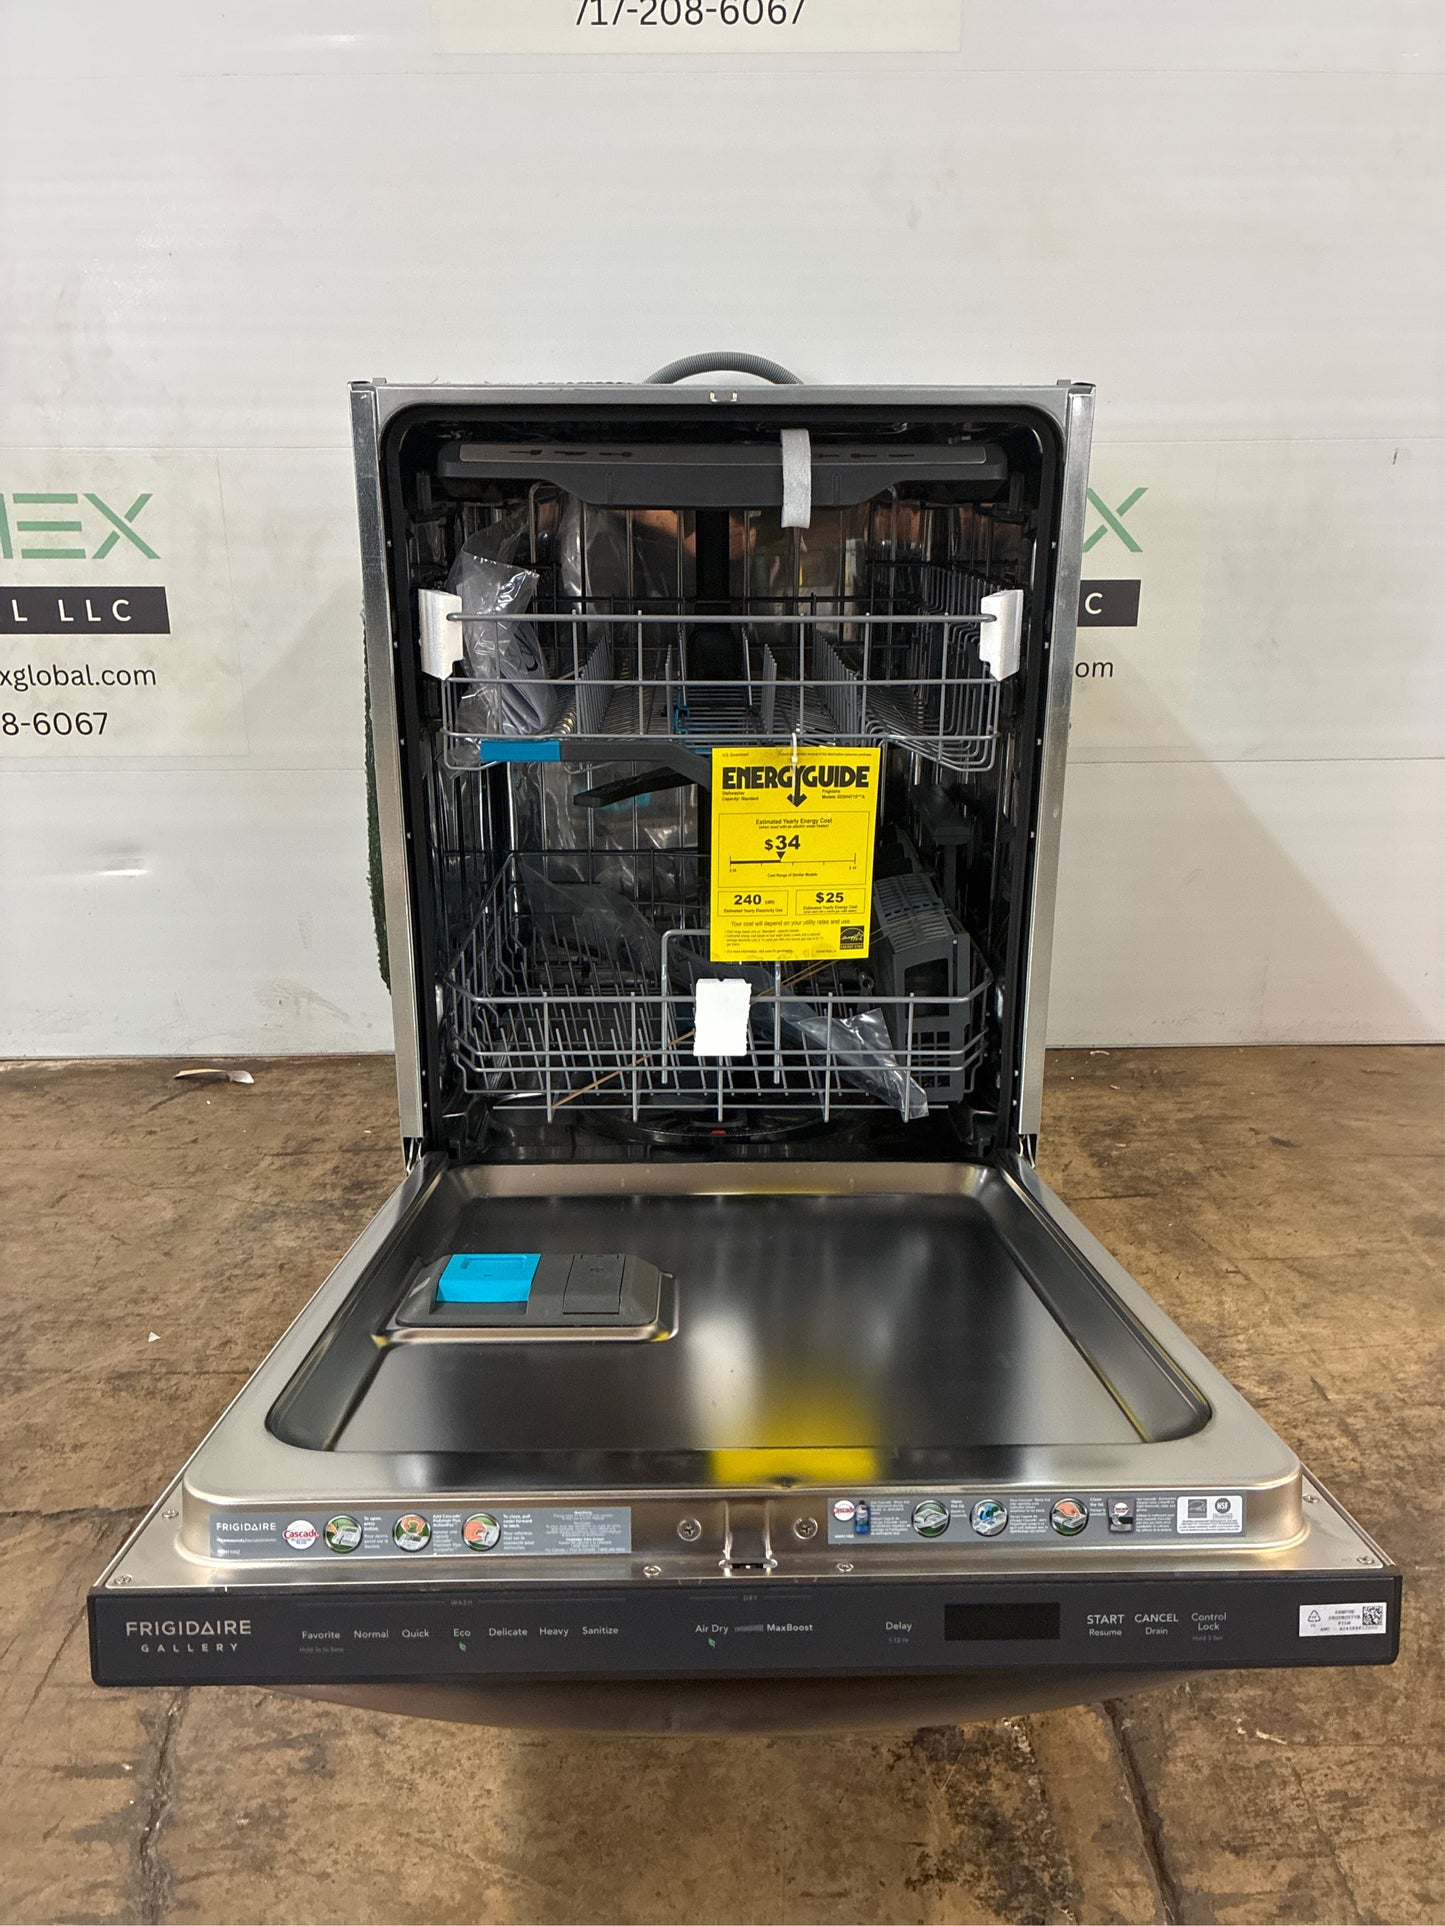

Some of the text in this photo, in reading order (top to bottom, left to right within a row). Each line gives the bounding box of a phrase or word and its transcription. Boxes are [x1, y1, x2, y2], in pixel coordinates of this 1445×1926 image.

[58, 599, 132, 622] LLC
[2, 712, 108, 735] 8-6067
[783, 818, 799, 826] Yearly
[800, 818, 818, 826] Energy
[764, 834, 801, 850] $34
[733, 894, 762, 905] 240
[815, 892, 844, 904] $25
[803, 919, 816, 927] utility
[1216, 1501, 1230, 1511] NSF
[216, 1522, 277, 1532] FRIGIDAIRE
[282, 1530, 320, 1540] Cascade
[1086, 1614, 1125, 1625] START
[1134, 1613, 1179, 1623] CANCEL
[1191, 1611, 1227, 1622] Control
[126, 1620, 252, 1637] FRIGIDAIRE
[582, 1625, 619, 1635] Sanitize
[694, 1624, 729, 1635] Air Dry
[766, 1623, 814, 1632] MaxBoost
[885, 1621, 912, 1632] Delay
[1145, 1626, 1168, 1635] Drain
[1197, 1622, 1220, 1631] Lock
[301, 1630, 341, 1640] Favorite
[353, 1629, 389, 1639] Normal
[402, 1628, 430, 1639] Quick
[453, 1628, 471, 1638] Eco
[488, 1627, 528, 1637] Delicate
[539, 1626, 569, 1638] Heavy
[1089, 1627, 1122, 1637] Resume
[141, 1643, 239, 1653] GALLERY
